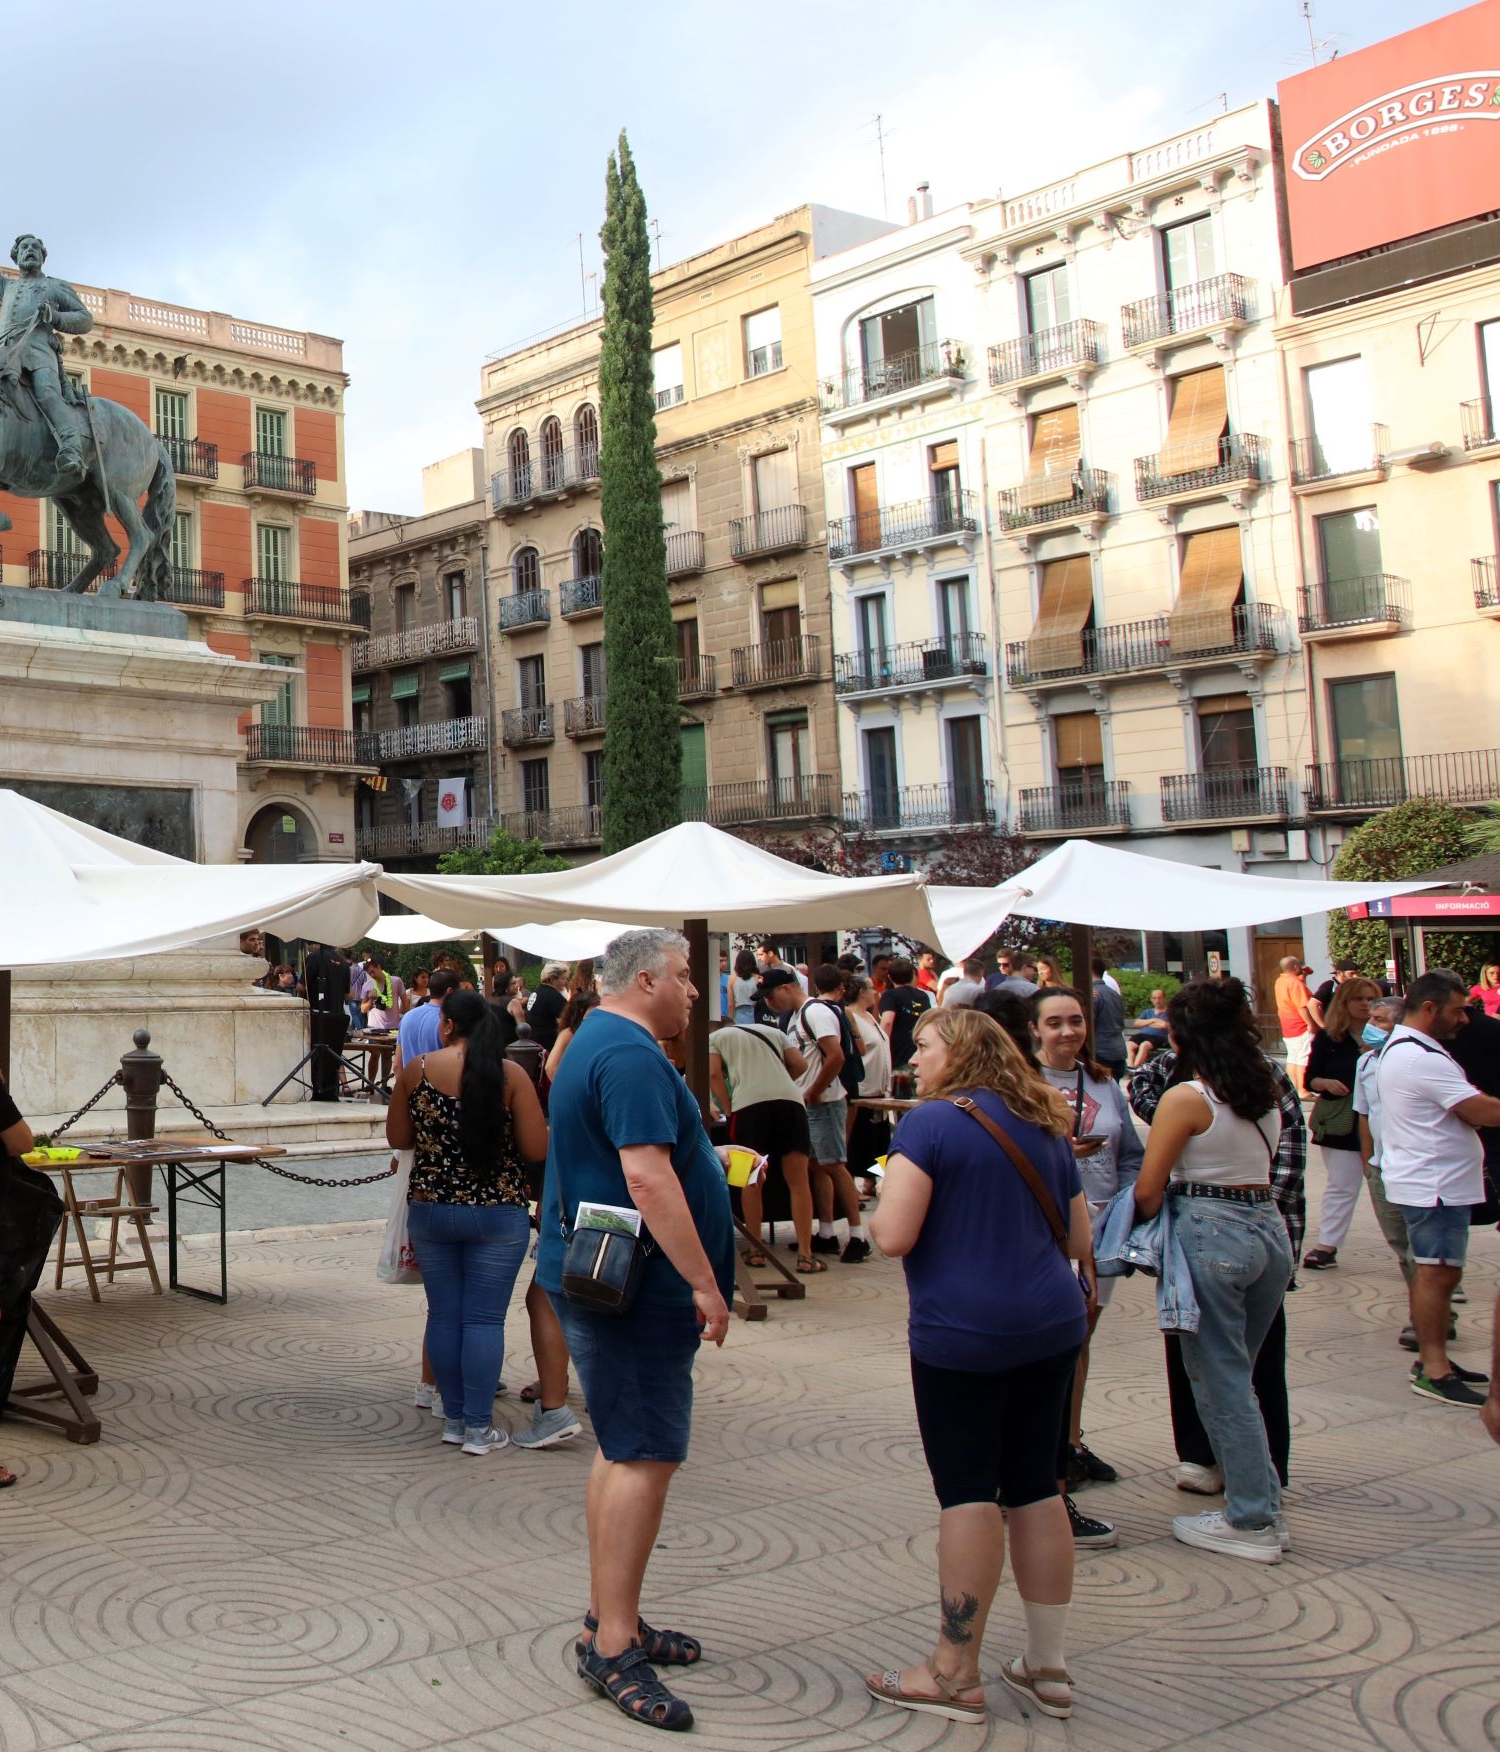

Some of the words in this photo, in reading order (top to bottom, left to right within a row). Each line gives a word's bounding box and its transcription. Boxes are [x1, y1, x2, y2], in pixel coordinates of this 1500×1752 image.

[1322, 82, 1489, 158] BORGES
[1353, 132, 1419, 165] FUNDADA
[1435, 901, 1490, 910] INFORMACIÓ
